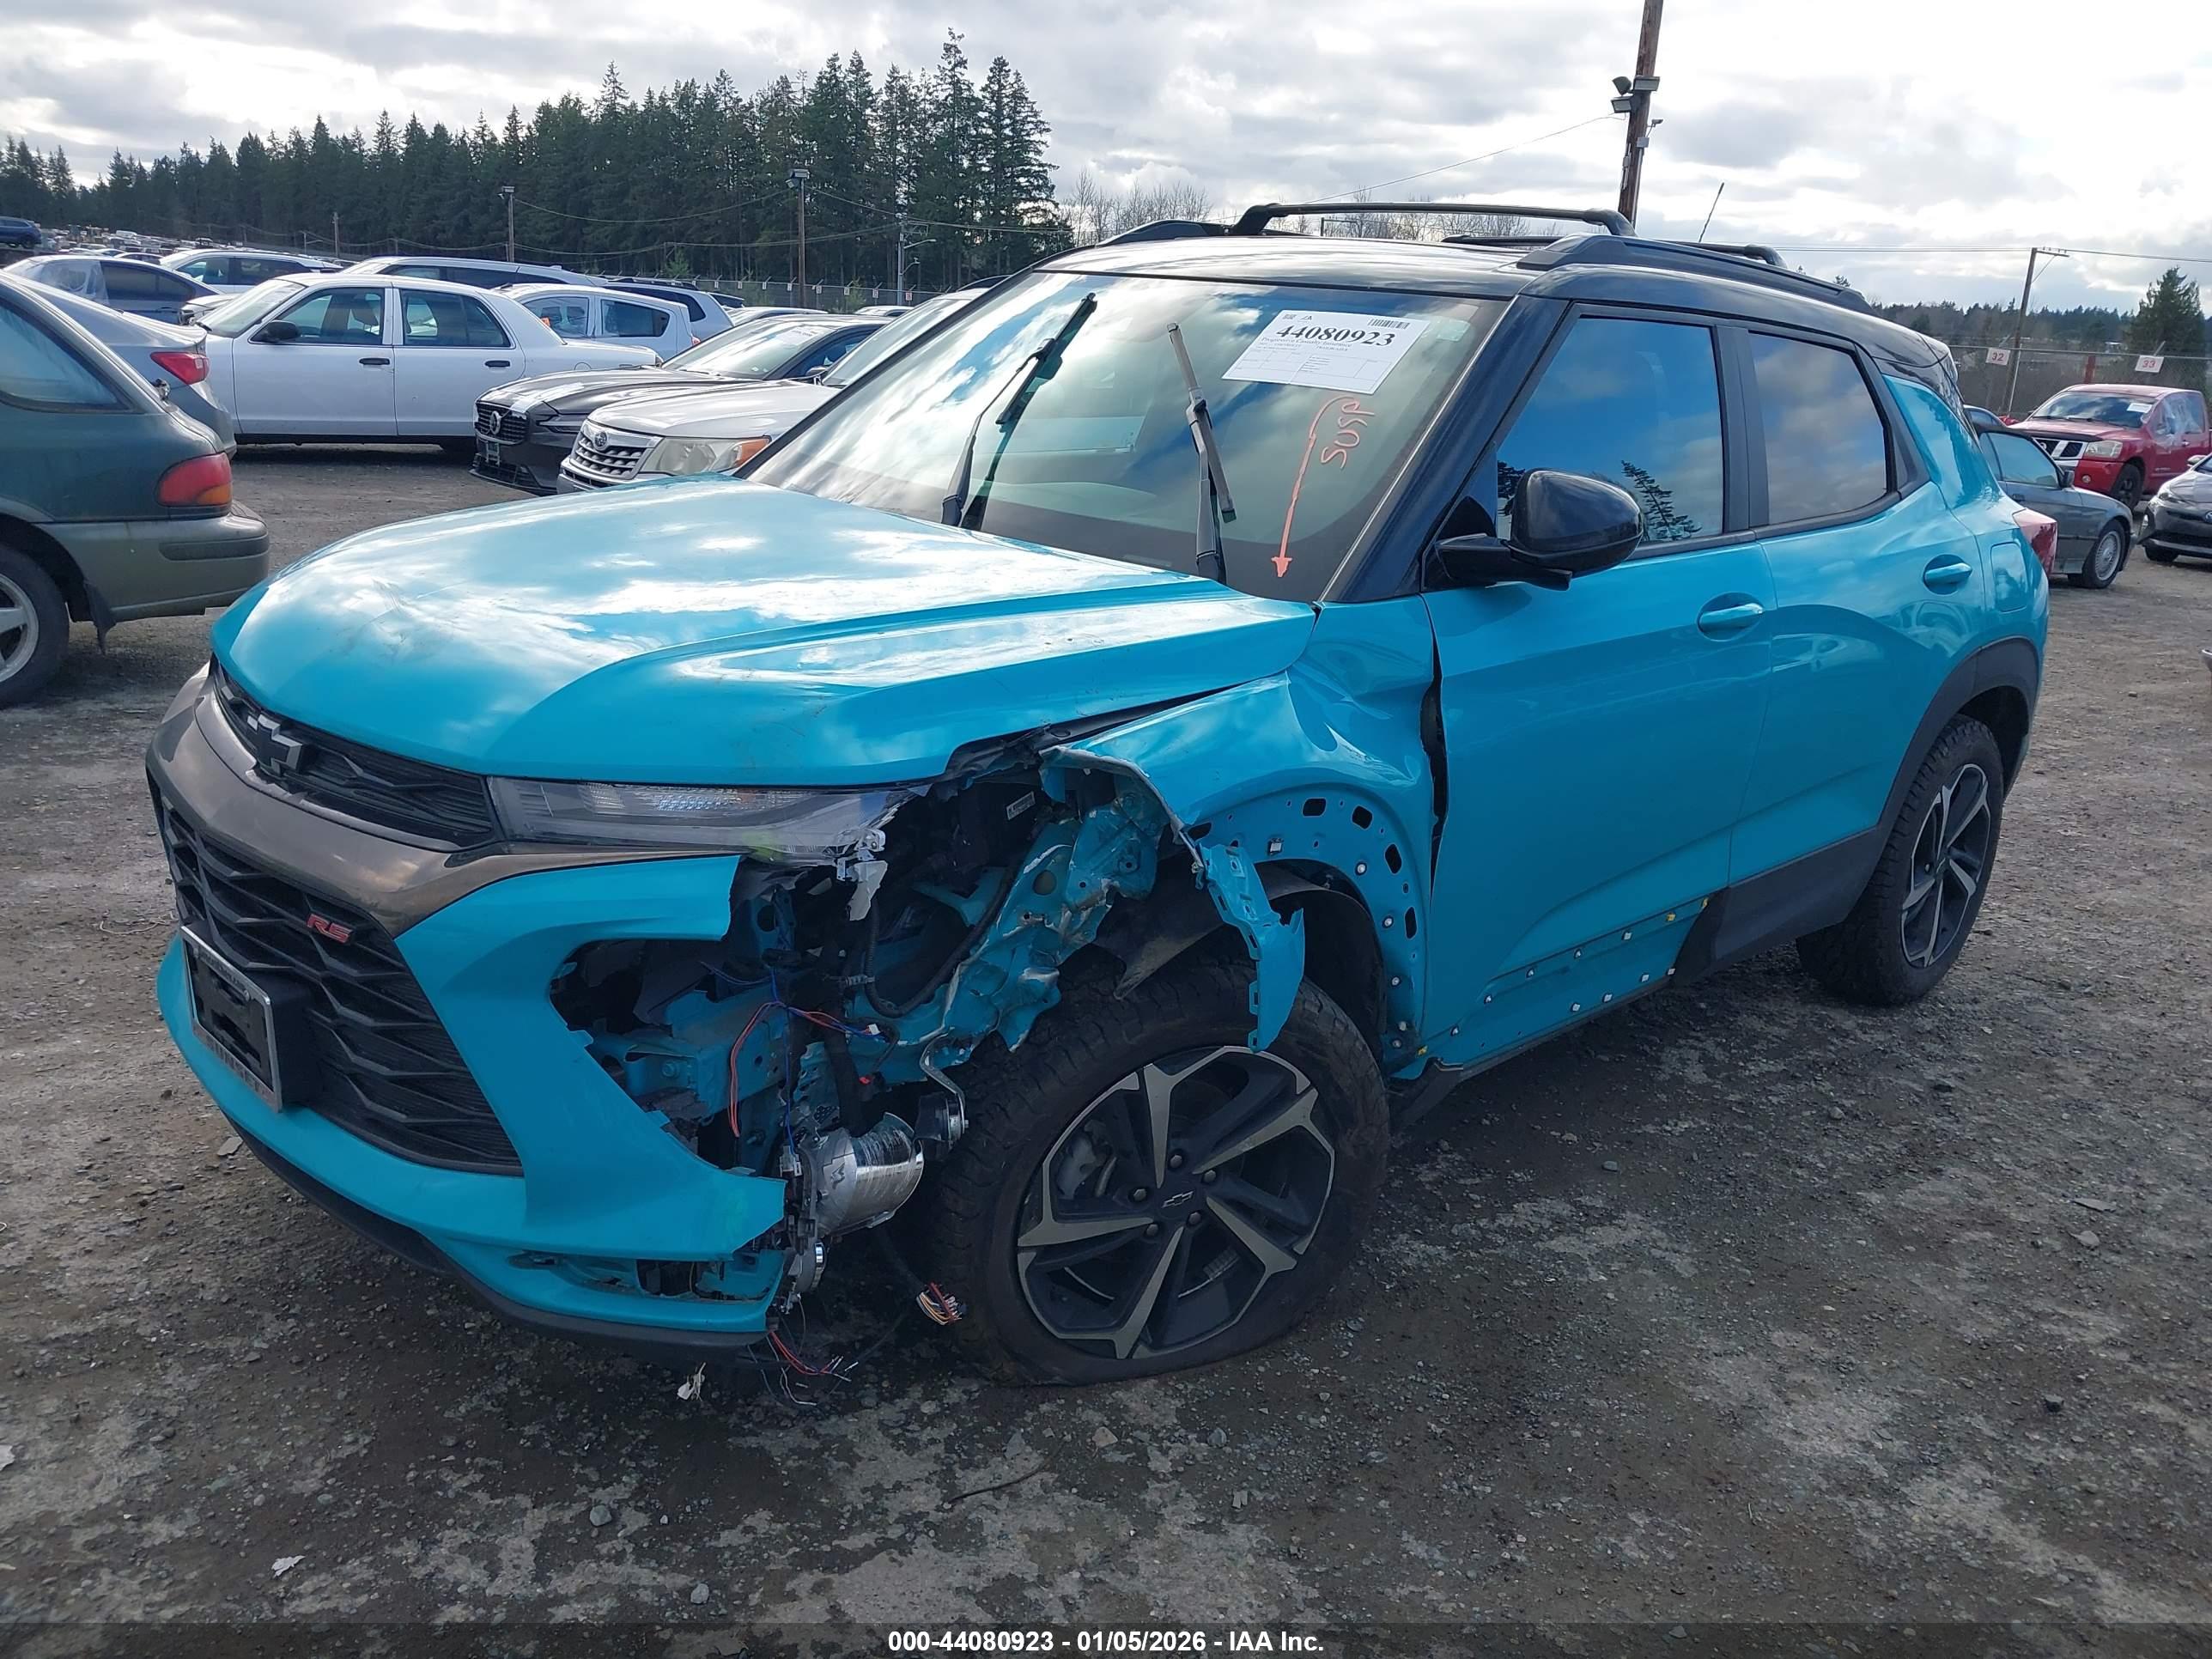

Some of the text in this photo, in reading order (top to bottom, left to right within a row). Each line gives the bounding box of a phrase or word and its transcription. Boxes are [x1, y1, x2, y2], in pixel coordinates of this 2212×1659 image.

[1275, 324, 1396, 347] 44080923
[1991, 352, 2004, 362] 32
[307, 913, 354, 944] RS
